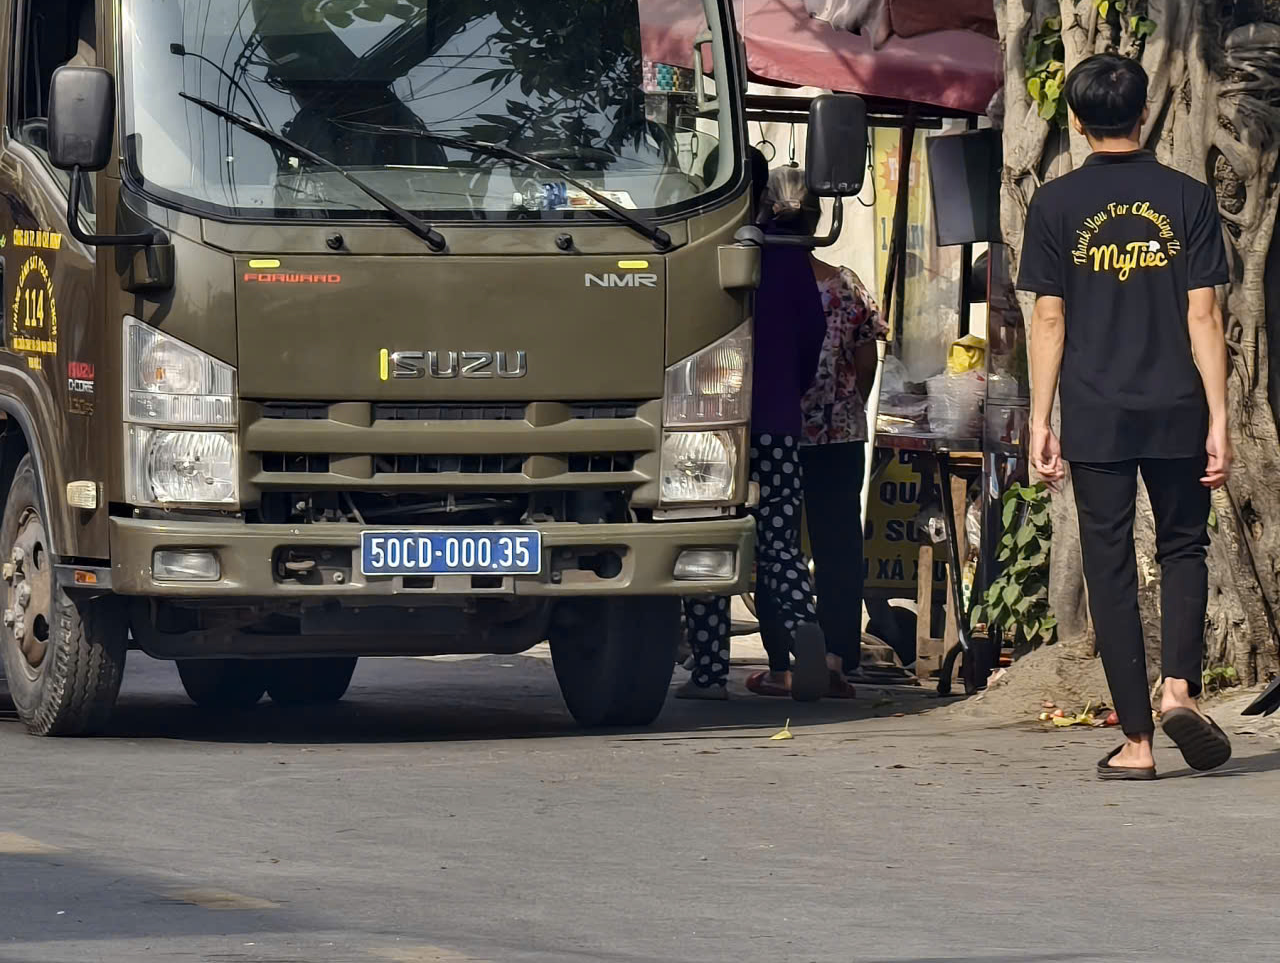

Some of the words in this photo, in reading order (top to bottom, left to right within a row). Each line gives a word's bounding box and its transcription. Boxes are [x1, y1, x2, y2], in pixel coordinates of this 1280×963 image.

[1072, 230, 1092, 265] Thank
[1084, 211, 1108, 233] You
[243, 273, 342, 284] FORWARD
[585, 273, 658, 287] NMR
[24, 288, 45, 328] 114
[68, 362, 95, 379] ISUZU
[379, 348, 528, 381] ISUZU
[370, 537, 530, 568] 50CD-000.35
